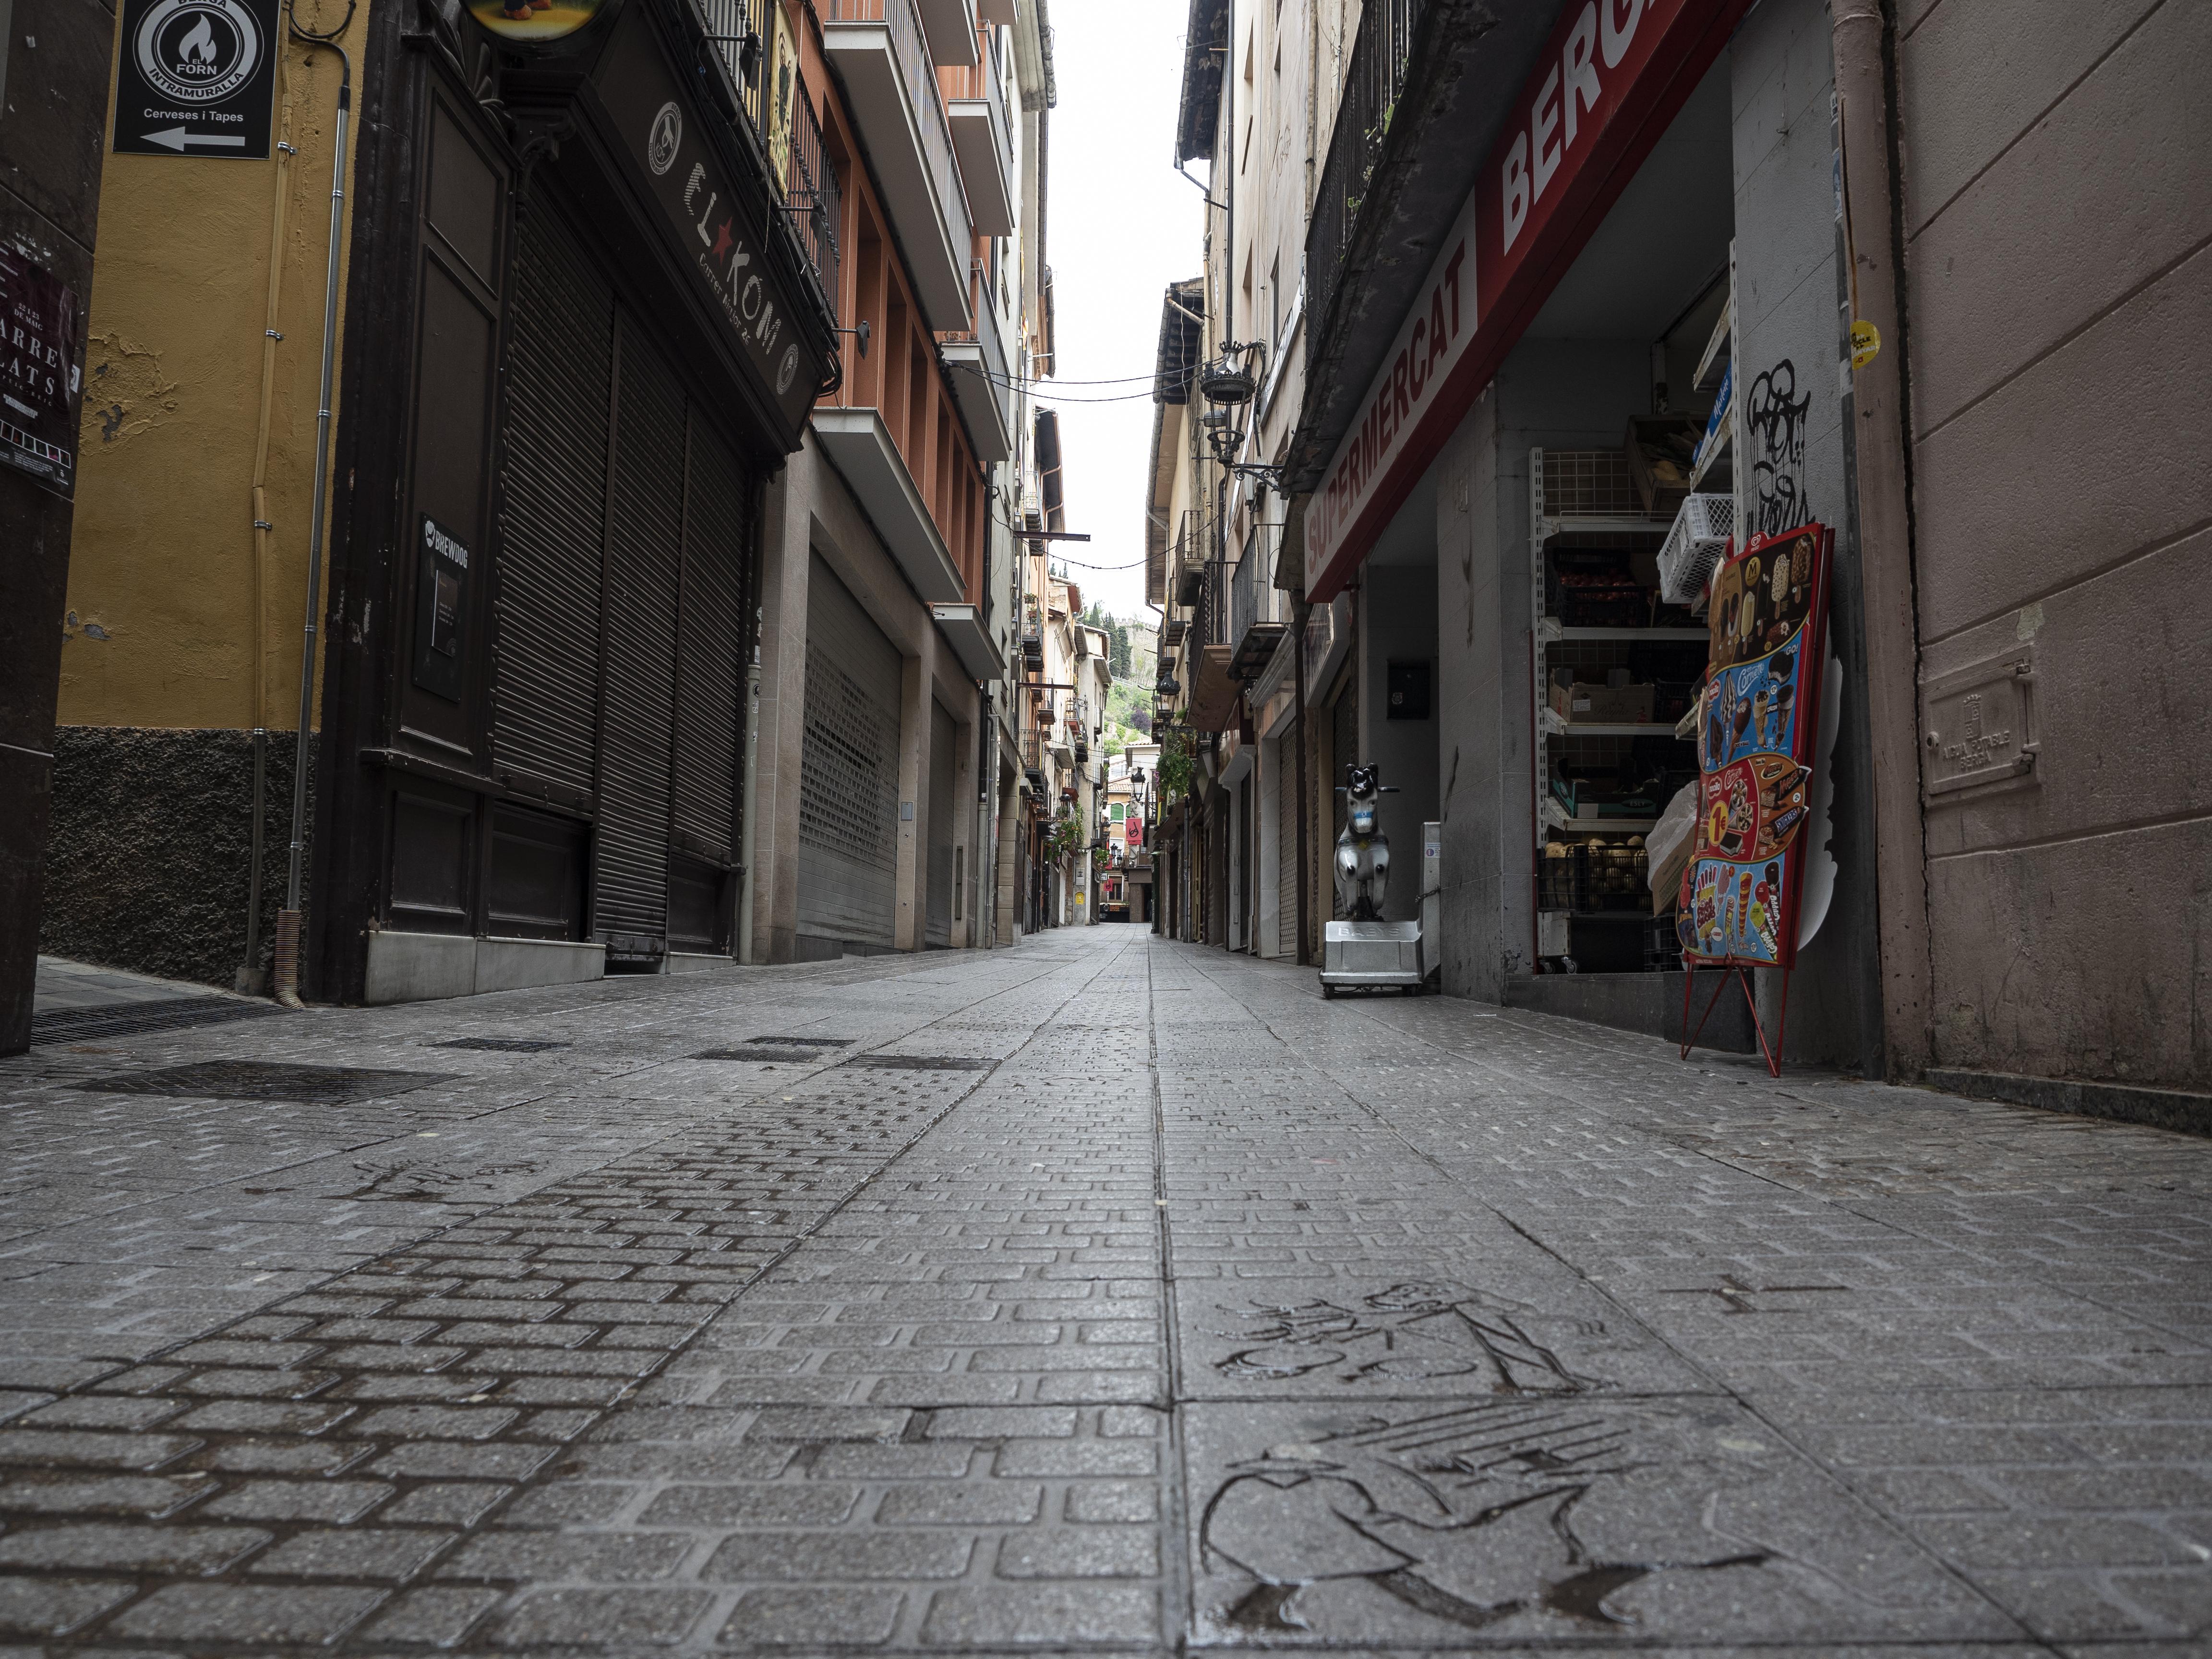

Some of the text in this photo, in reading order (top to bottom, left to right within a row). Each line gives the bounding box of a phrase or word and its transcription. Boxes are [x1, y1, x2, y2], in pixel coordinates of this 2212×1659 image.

[149, 68, 244, 97] INTRAMURALLA
[177, 64, 217, 75] FORN
[144, 108, 244, 123] Cerveses i Tapes
[1503, 0, 1655, 256] BERG
[684, 163, 717, 247] EL
[699, 253, 722, 294] Carrer
[722, 293, 741, 328] Major
[14, 309, 43, 331] DE MAIG
[18, 302, 26, 312] 22
[32, 311, 39, 320] 23
[1309, 237, 1465, 575] SUPERMERCAT
[435, 530, 468, 569] BREWDOG
[1786, 644, 1799, 655] GO!
[1737, 662, 1765, 696] Cornetto
[1944, 731, 2010, 760] AIGUA POTABLE
[1960, 751, 1992, 769] BERGA
[1712, 806, 1726, 842] 1€
[1777, 810, 1798, 830] SNICKERS
